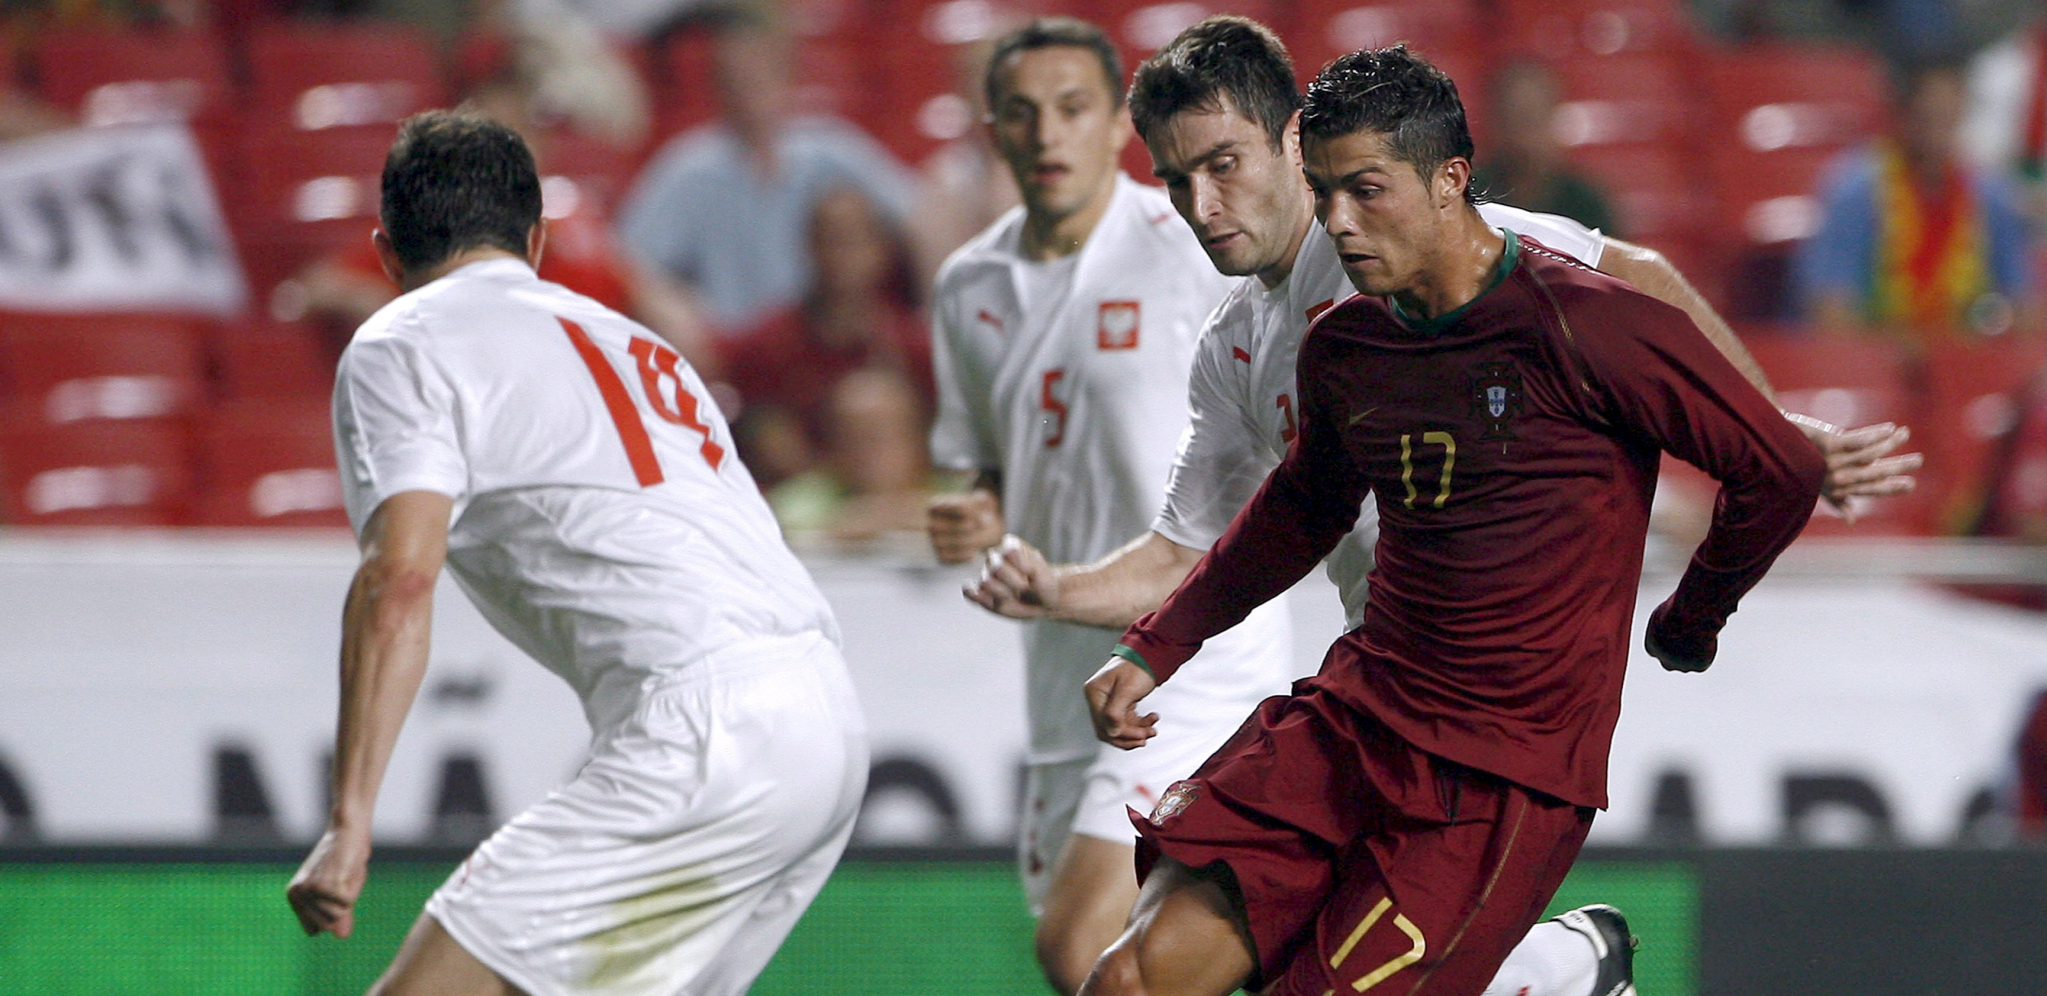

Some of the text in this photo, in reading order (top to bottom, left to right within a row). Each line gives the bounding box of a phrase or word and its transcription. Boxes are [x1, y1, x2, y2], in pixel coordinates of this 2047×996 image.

[1042, 369, 1067, 448] 5
[1401, 432, 1456, 510] 17
[1329, 896, 1426, 993] 17
